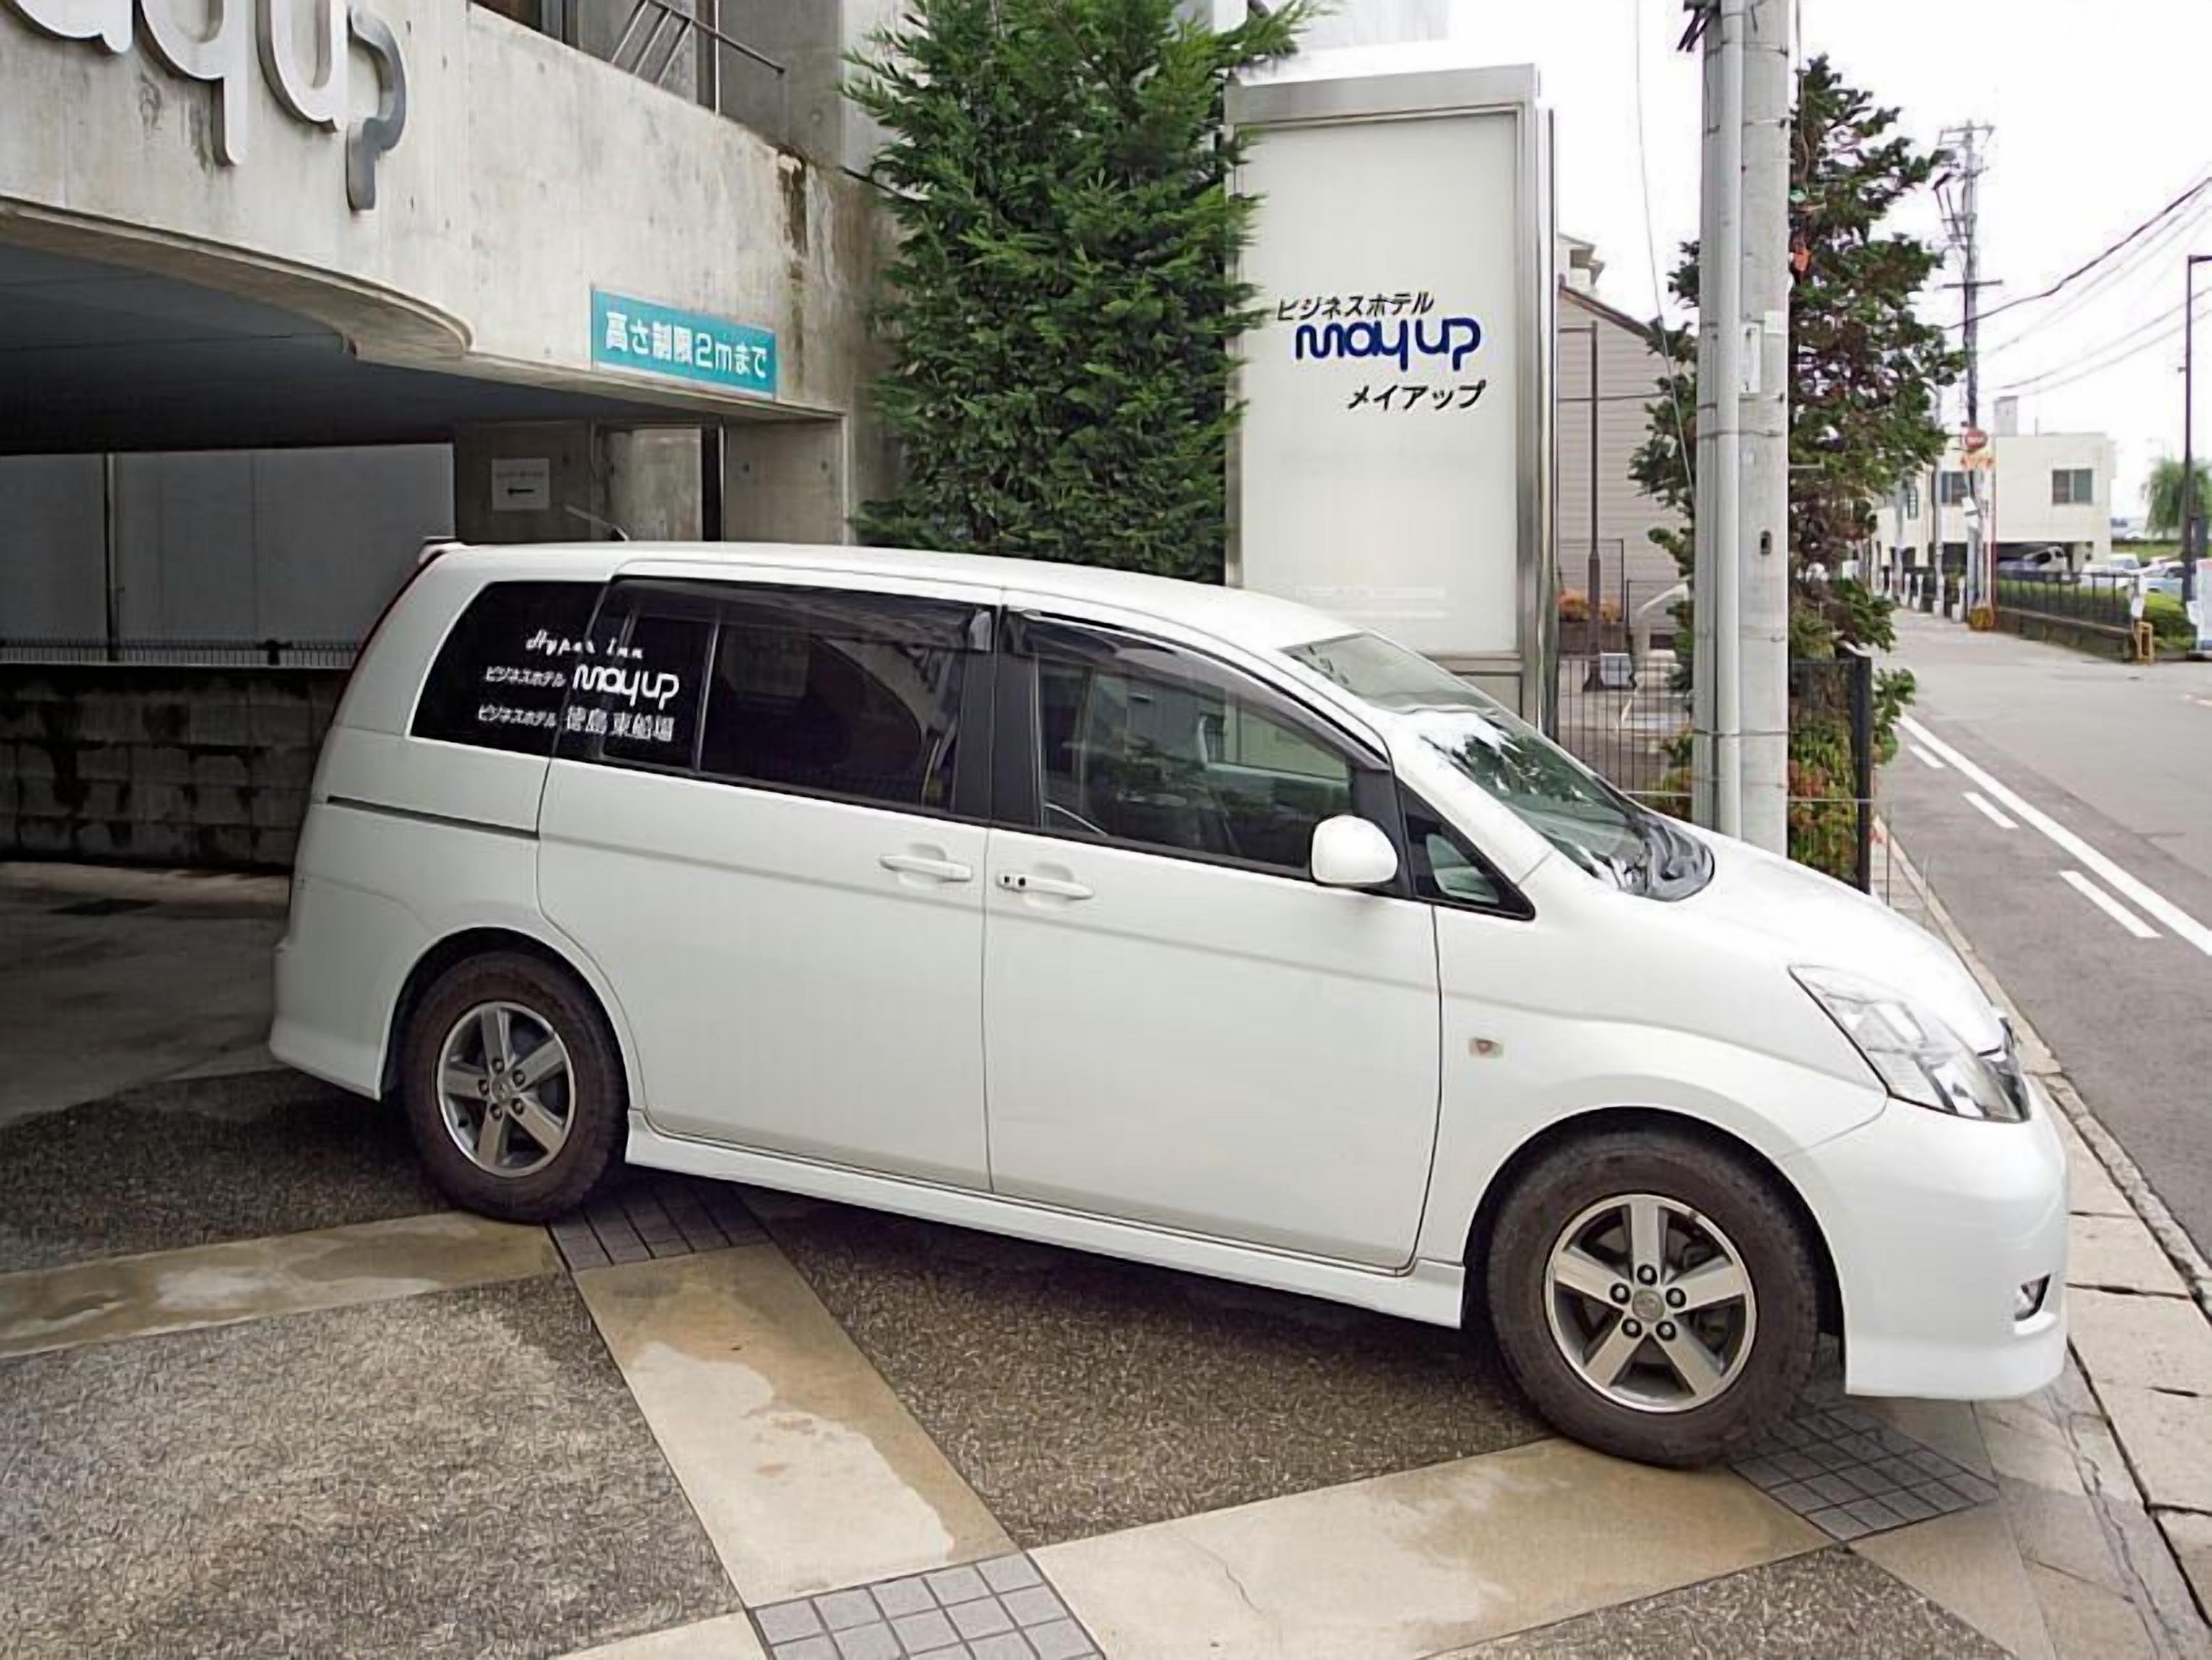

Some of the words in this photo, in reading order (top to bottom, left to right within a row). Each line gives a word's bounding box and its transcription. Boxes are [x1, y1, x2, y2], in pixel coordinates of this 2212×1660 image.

[1277, 291, 1435, 321] ビジネスホテル
[1347, 379, 1487, 411] メイアップ
